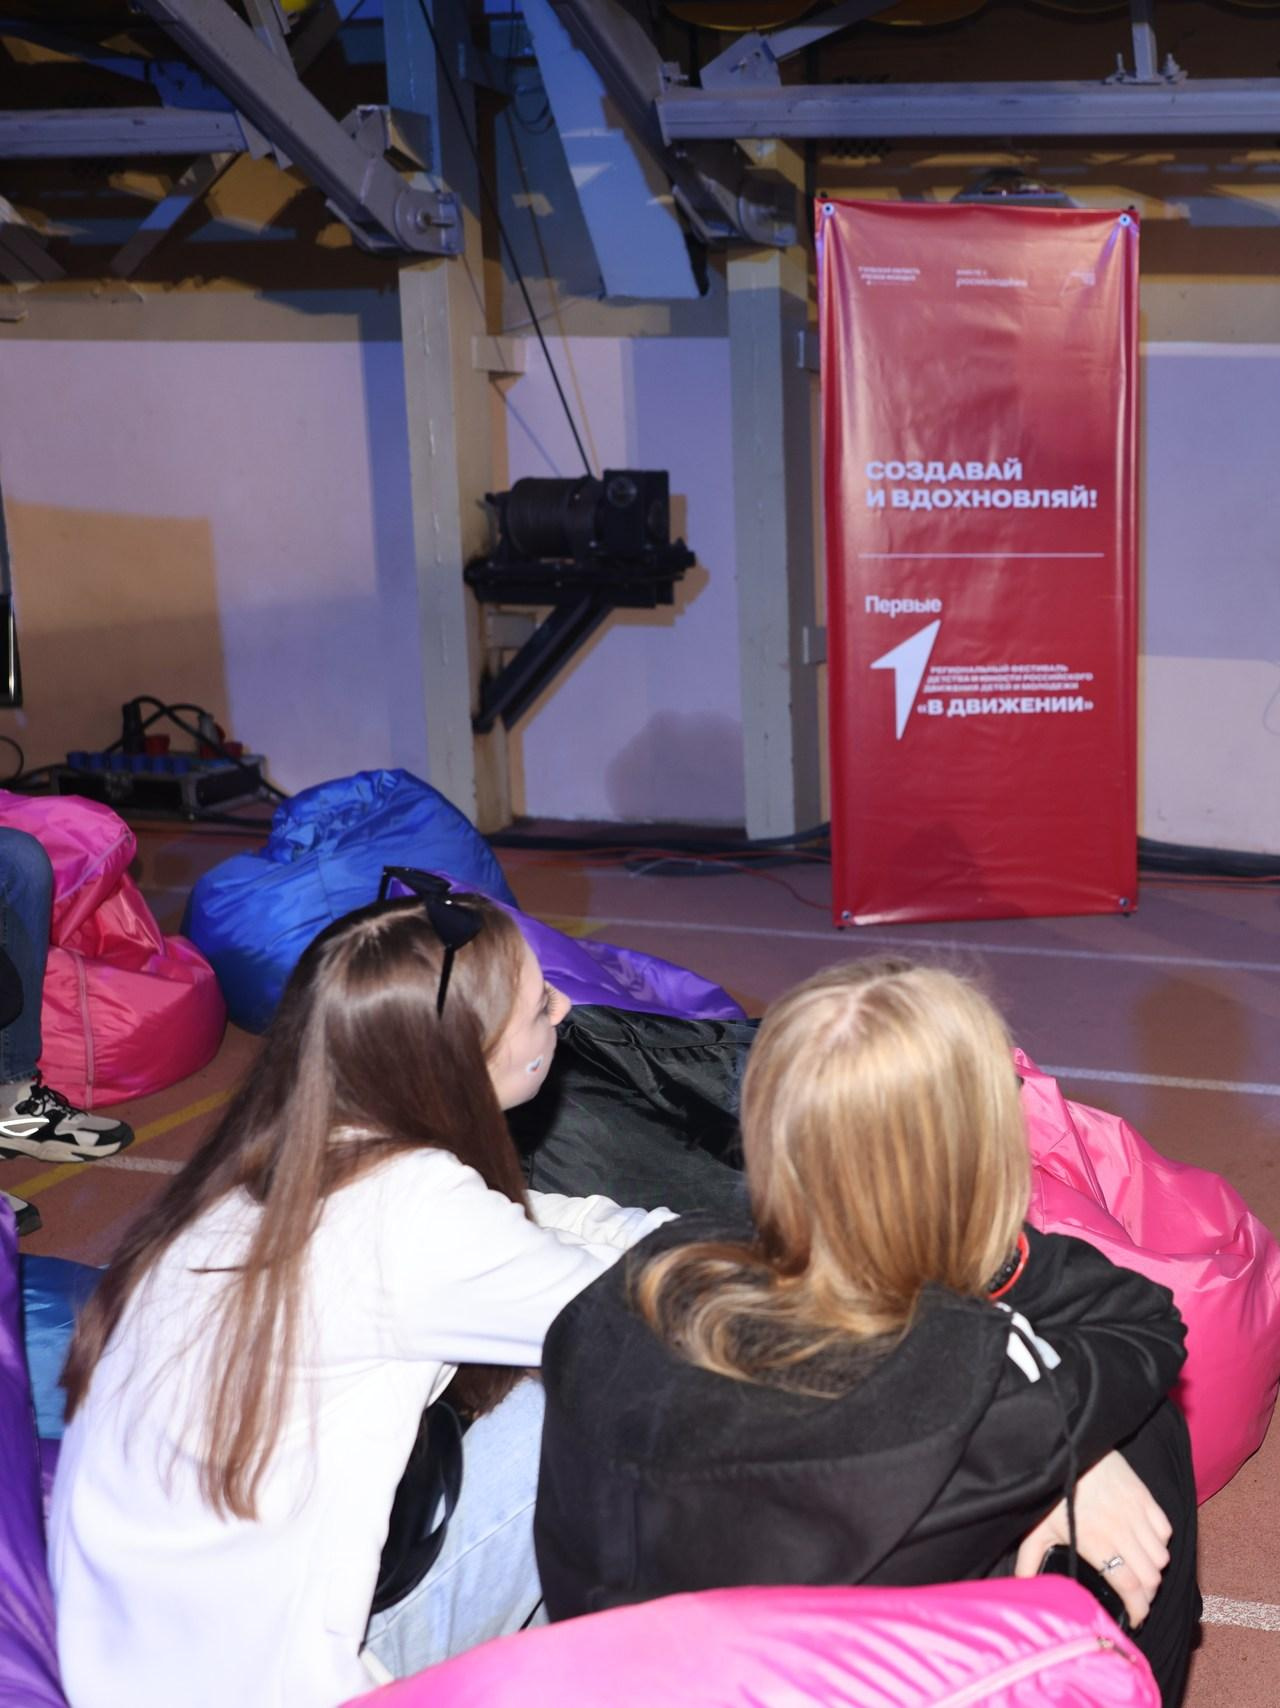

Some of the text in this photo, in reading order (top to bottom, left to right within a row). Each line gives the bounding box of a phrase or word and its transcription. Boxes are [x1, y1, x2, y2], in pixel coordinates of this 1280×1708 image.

[865, 458, 1022, 483] СОЗДАВАЙ
[865, 485, 1098, 511] И ВДОХНОВЛЯЙ!
[865, 596, 942, 618] Первые
[917, 696, 1094, 718] «В ДВИЖЕНИИ»
